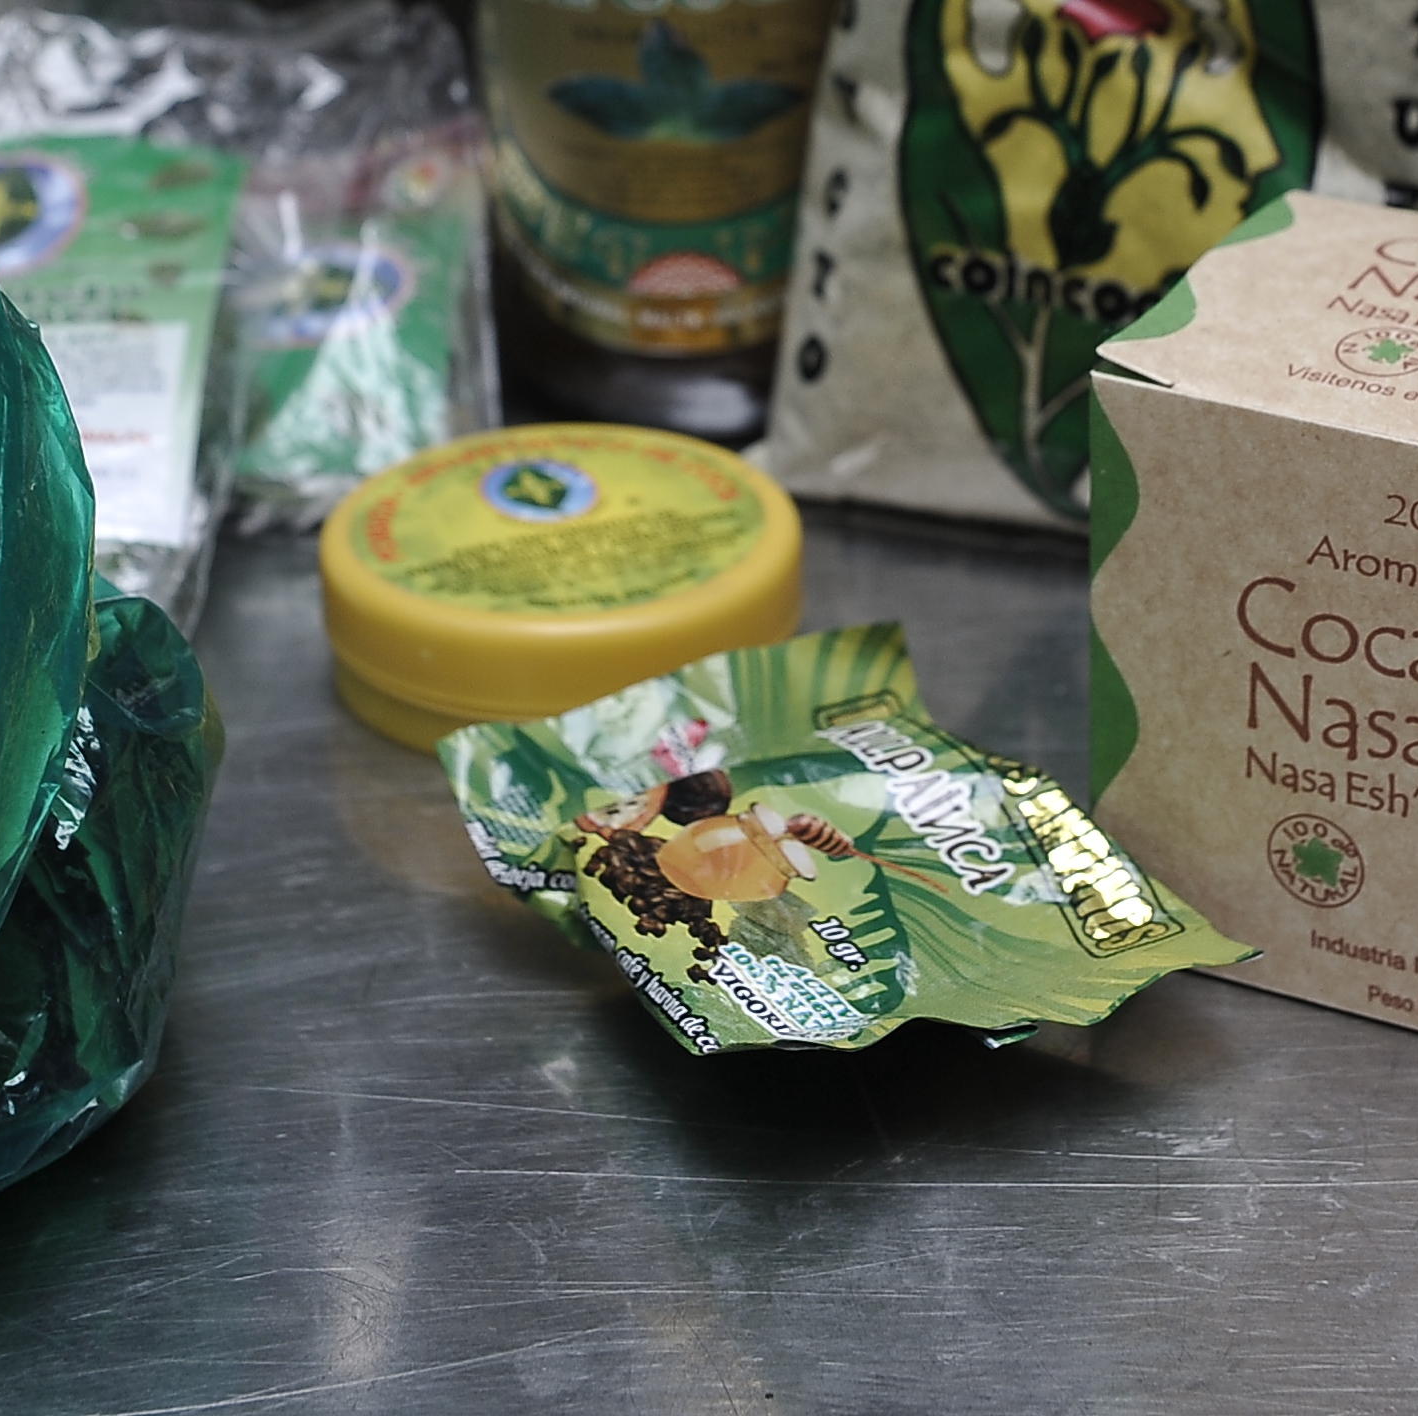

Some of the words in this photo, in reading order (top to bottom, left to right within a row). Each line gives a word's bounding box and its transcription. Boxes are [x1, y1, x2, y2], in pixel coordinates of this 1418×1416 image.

[1328, 295, 1409, 324] Nasa
[1246, 745, 1335, 802] Nasa
[1273, 849, 1358, 903] NATURAL
[810, 917, 850, 941] 10
[828, 942, 867, 971] gr.
[1311, 929, 1406, 970] Industria
[644, 974, 688, 1021] harina
[679, 1016, 706, 1037] de
[1368, 985, 1414, 1013] Peso
